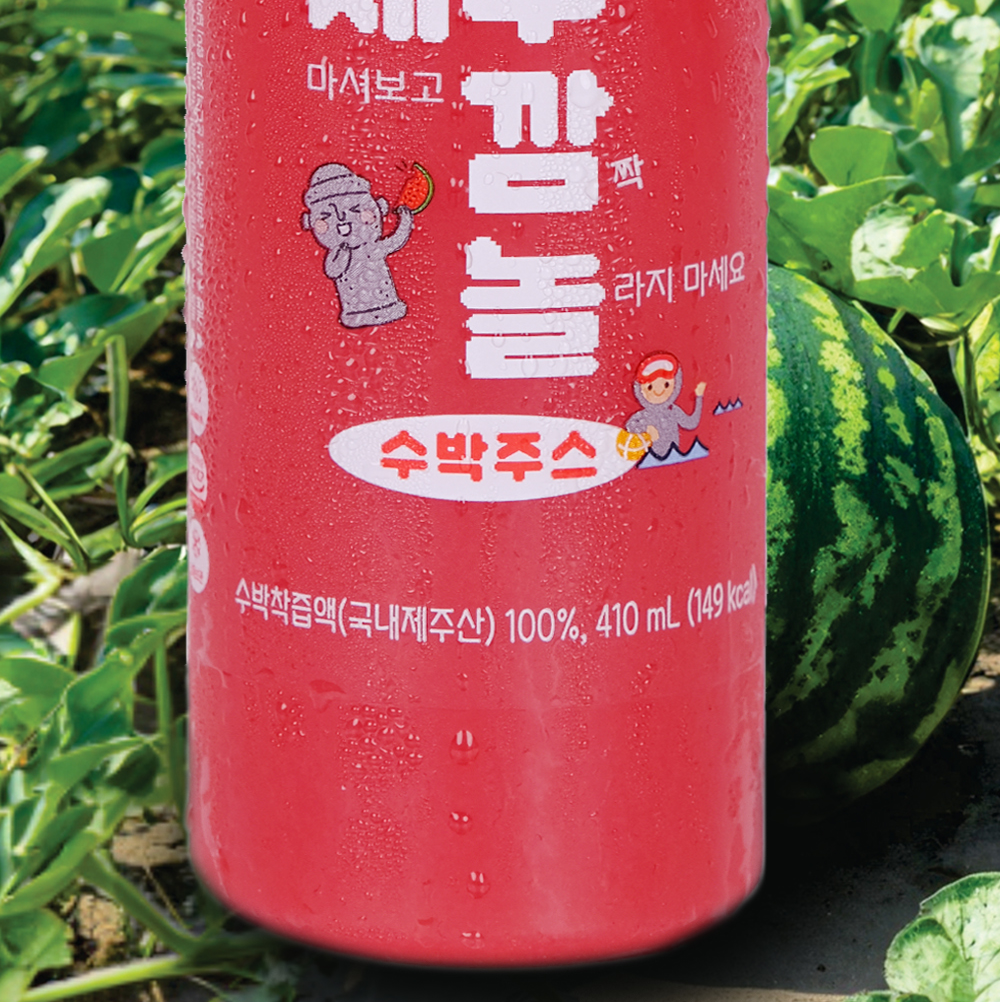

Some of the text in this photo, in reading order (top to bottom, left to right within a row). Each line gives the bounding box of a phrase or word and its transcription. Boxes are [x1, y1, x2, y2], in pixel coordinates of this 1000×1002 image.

[307, 64, 444, 104] 마셔보고
[614, 266, 673, 307] 라지
[684, 251, 745, 297] 마세요
[381, 430, 597, 482] 수박주스
[234, 577, 495, 647] 수박착즙액(국내제주산)
[505, 606, 587, 645] 100%,
[595, 600, 639, 638] 410
[646, 594, 680, 633] mL
[687, 582, 724, 627] (149
